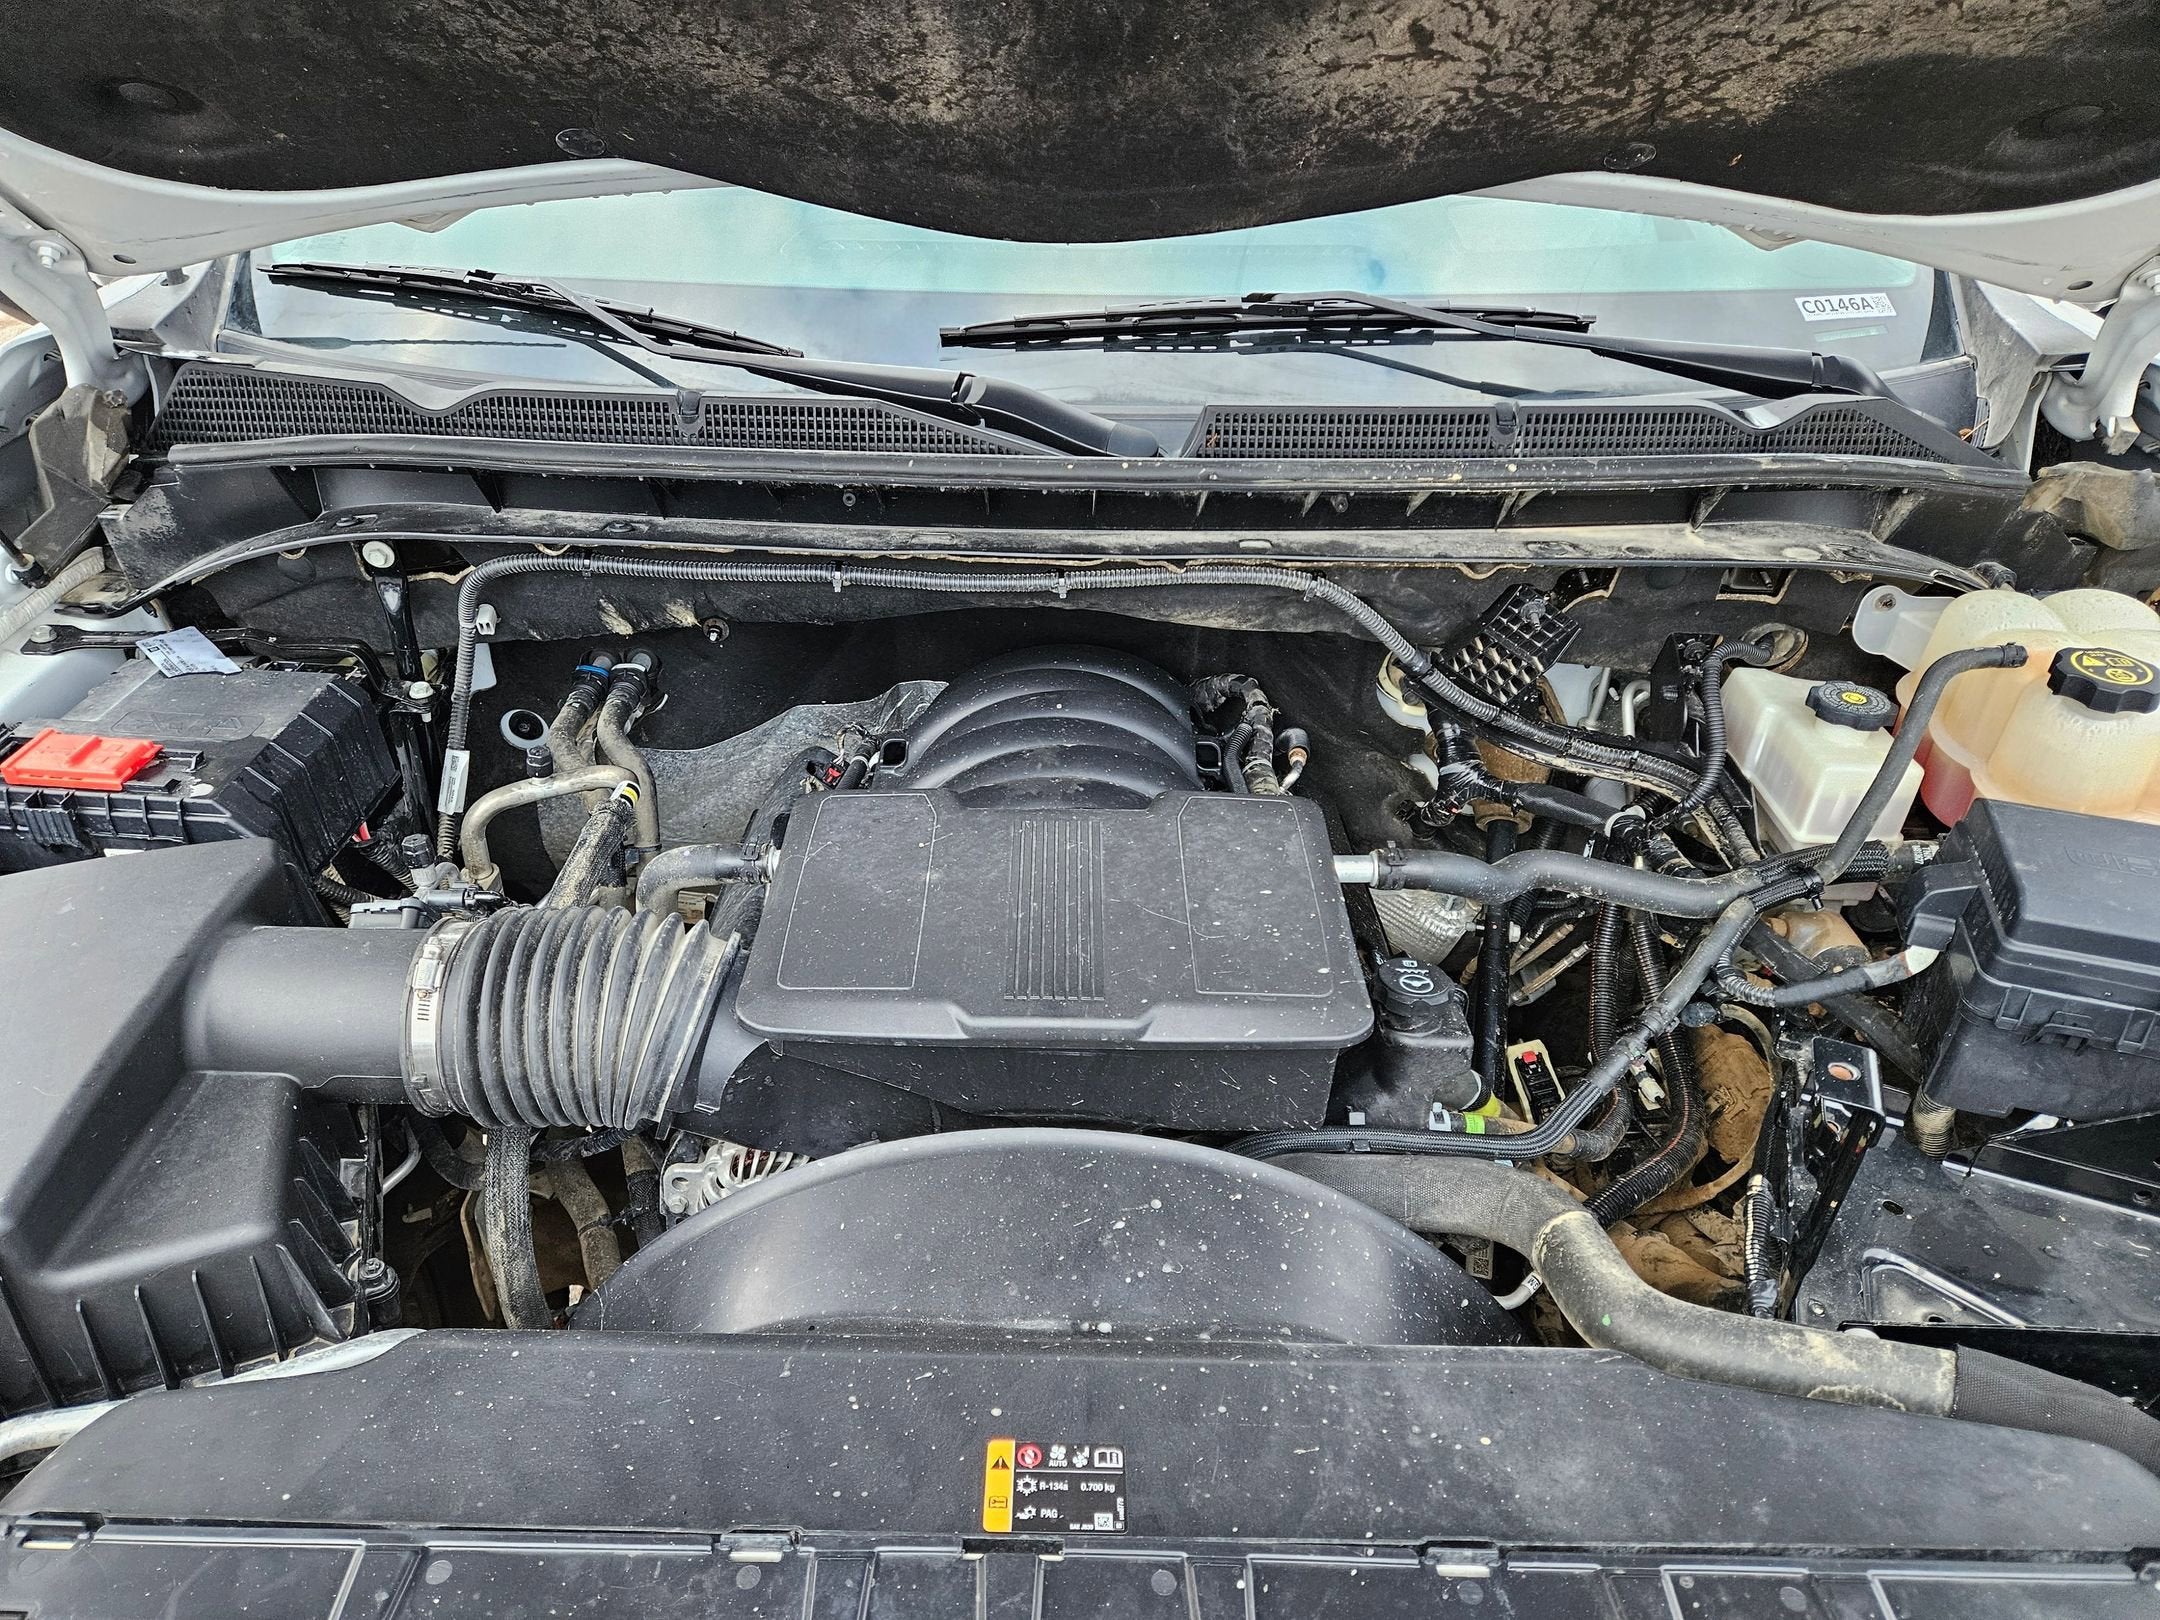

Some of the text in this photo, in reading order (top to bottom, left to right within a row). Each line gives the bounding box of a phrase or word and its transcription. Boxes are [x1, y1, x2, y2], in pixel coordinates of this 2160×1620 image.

[1801, 297, 1874, 314] C0146A
[1048, 1459, 1068, 1468] AUTO
[1039, 1481, 1069, 1492] R-134a
[1080, 1482, 1116, 1494] 0.700 kg
[1040, 1508, 1059, 1519] PAG
